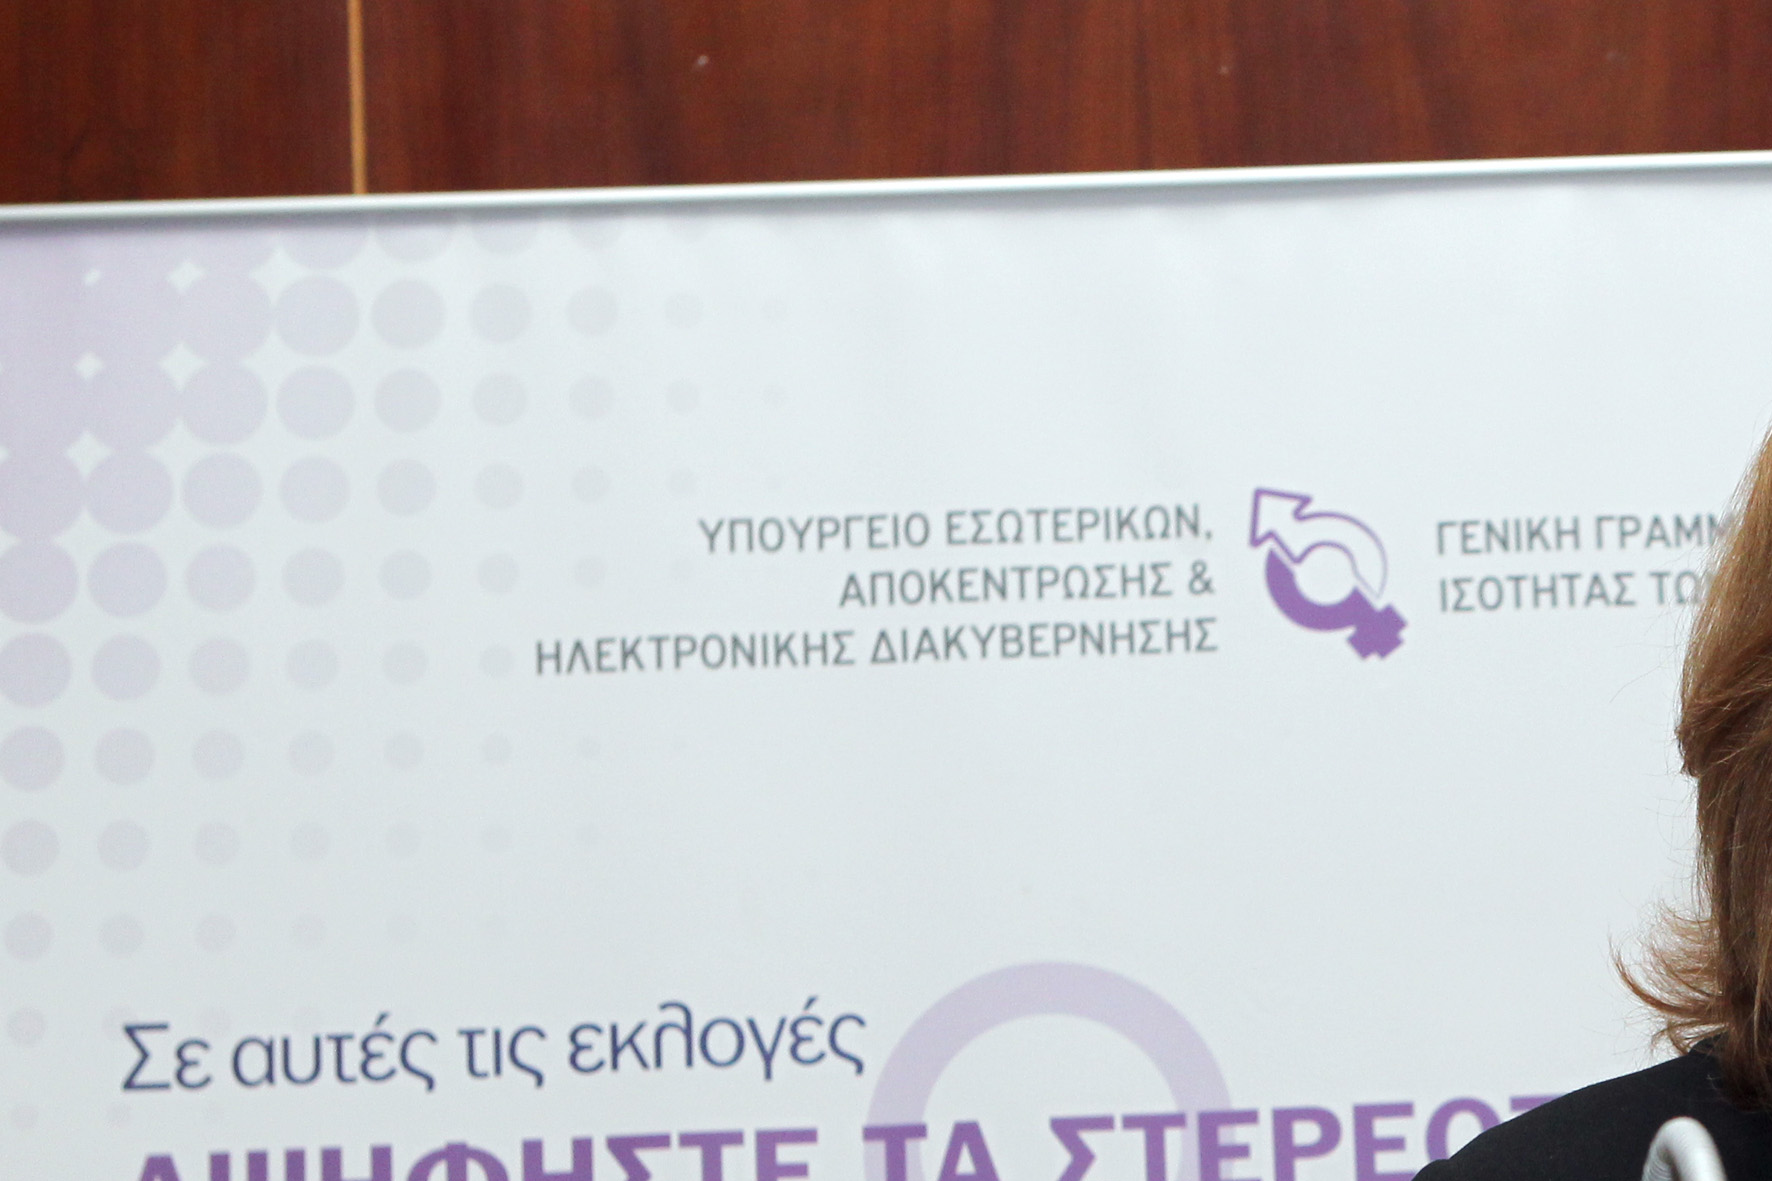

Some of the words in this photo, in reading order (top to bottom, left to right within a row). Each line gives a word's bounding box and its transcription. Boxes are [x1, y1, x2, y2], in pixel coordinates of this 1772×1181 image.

[698, 511, 932, 555] ΥΠΟΥΡΓΕΙΟ
[945, 503, 1214, 548] ΕΣΩΤΕΡΙΚΩΝ,
[1436, 515, 1581, 556] ΓΕΝΙΚΗ
[838, 560, 1173, 608] ΑΠΟΚΕΝΤΡΩΣΗΣ
[1187, 559, 1216, 597] &
[1439, 571, 1638, 613] ΙΣΟΤΗΤΑΣ
[535, 630, 856, 676] ΗΛΕΚΤΡΟΝΙΚΗΣ
[869, 616, 1219, 665] ΔΙΑΚΥΒΕΡΝΗΣΗΣ
[122, 1022, 213, 1092] Σε
[231, 1012, 437, 1092] αυτές
[458, 1025, 547, 1089] τις
[568, 996, 866, 1082] εκλογές
